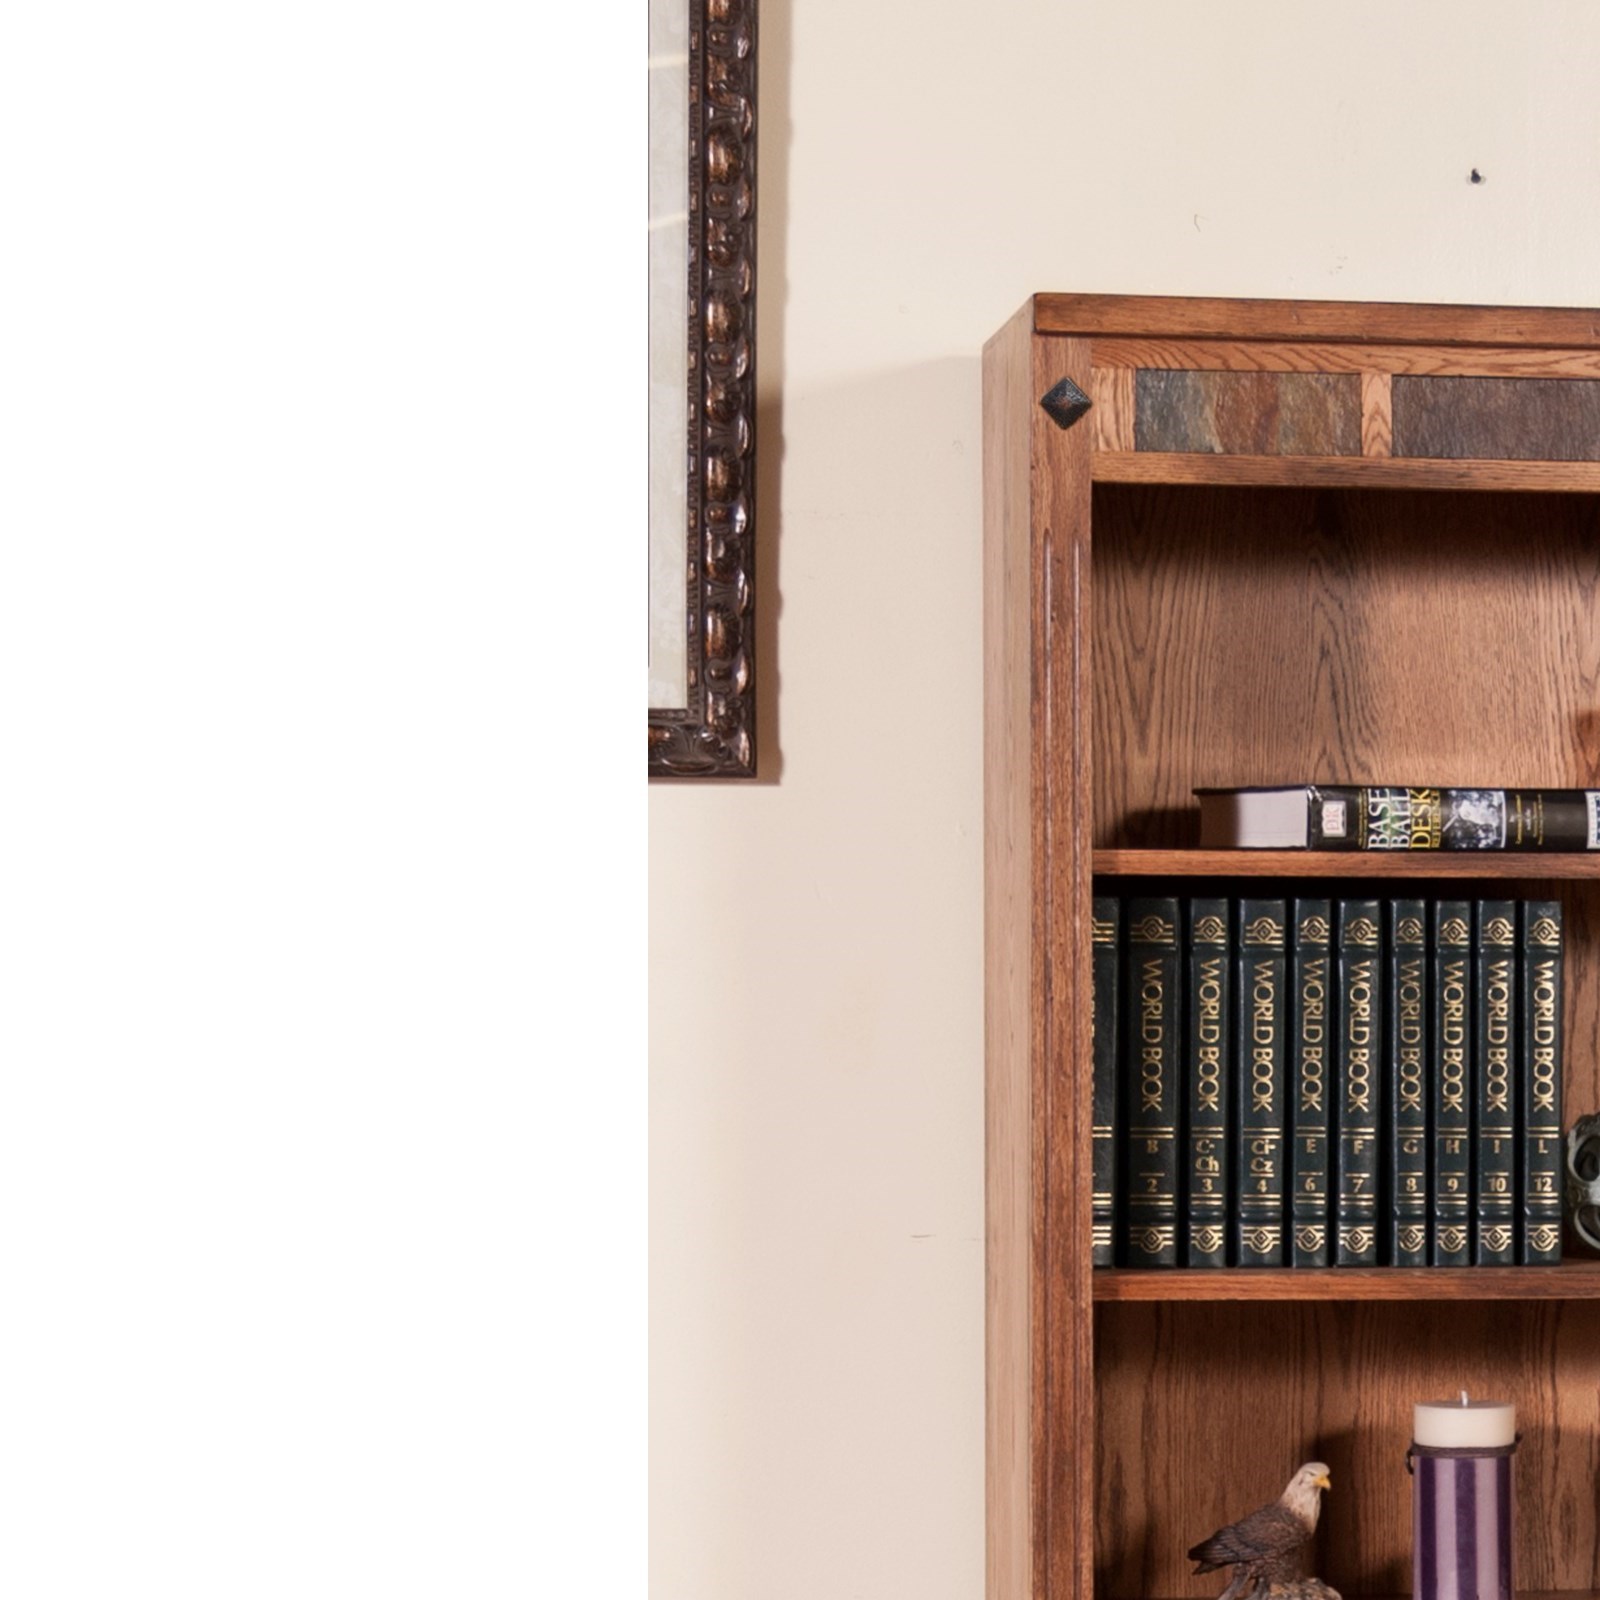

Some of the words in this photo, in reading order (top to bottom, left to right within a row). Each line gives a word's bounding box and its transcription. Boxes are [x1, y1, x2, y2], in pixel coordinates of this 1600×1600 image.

[1325, 807, 1340, 832] DK
[1367, 788, 1391, 849] BASE
[1390, 788, 1411, 849] BALL
[1410, 789, 1432, 849] DESK
[1431, 789, 1441, 848] REFERENCE
[1141, 959, 1163, 1044] WORLD
[1199, 959, 1221, 1043] WORLD
[1252, 960, 1274, 1044] WORLD
[1302, 959, 1324, 1044] WORLD
[1349, 961, 1371, 1045] WORLD
[1401, 961, 1422, 1044] WORLD
[1443, 961, 1464, 1045] WORLD
[1487, 961, 1509, 1045] WORLD
[1533, 960, 1554, 1045] WORLD
[1141, 1048, 1162, 1112] BOOK
[1198, 1048, 1220, 1112] BOOK
[1252, 1048, 1274, 1112] BOOK
[1301, 1048, 1323, 1112] BOOK
[1348, 1049, 1370, 1113] BOOK
[1400, 1048, 1421, 1112] BOOK
[1442, 1049, 1464, 1113] BOOK
[1487, 1049, 1508, 1113] BOOK
[1533, 1048, 1554, 1113] BOOK
[1146, 1140, 1158, 1154] B
[1195, 1156, 1219, 1172] Ch
[1251, 1156, 1274, 1172] Cz
[1306, 1140, 1317, 1154] E
[1353, 1140, 1364, 1155] F
[1404, 1140, 1419, 1154] G
[1445, 1140, 1460, 1154] H
[1538, 1140, 1548, 1154] L
[1147, 1178, 1158, 1192] 2
[1202, 1178, 1213, 1193] 3
[1256, 1179, 1268, 1193] 4
[1305, 1177, 1316, 1191] 6
[1352, 1179, 1363, 1193] 7
[1406, 1178, 1417, 1192] 8
[1447, 1178, 1458, 1192] 9
[1487, 1178, 1506, 1192] 10
[1533, 1178, 1552, 1192] 12
